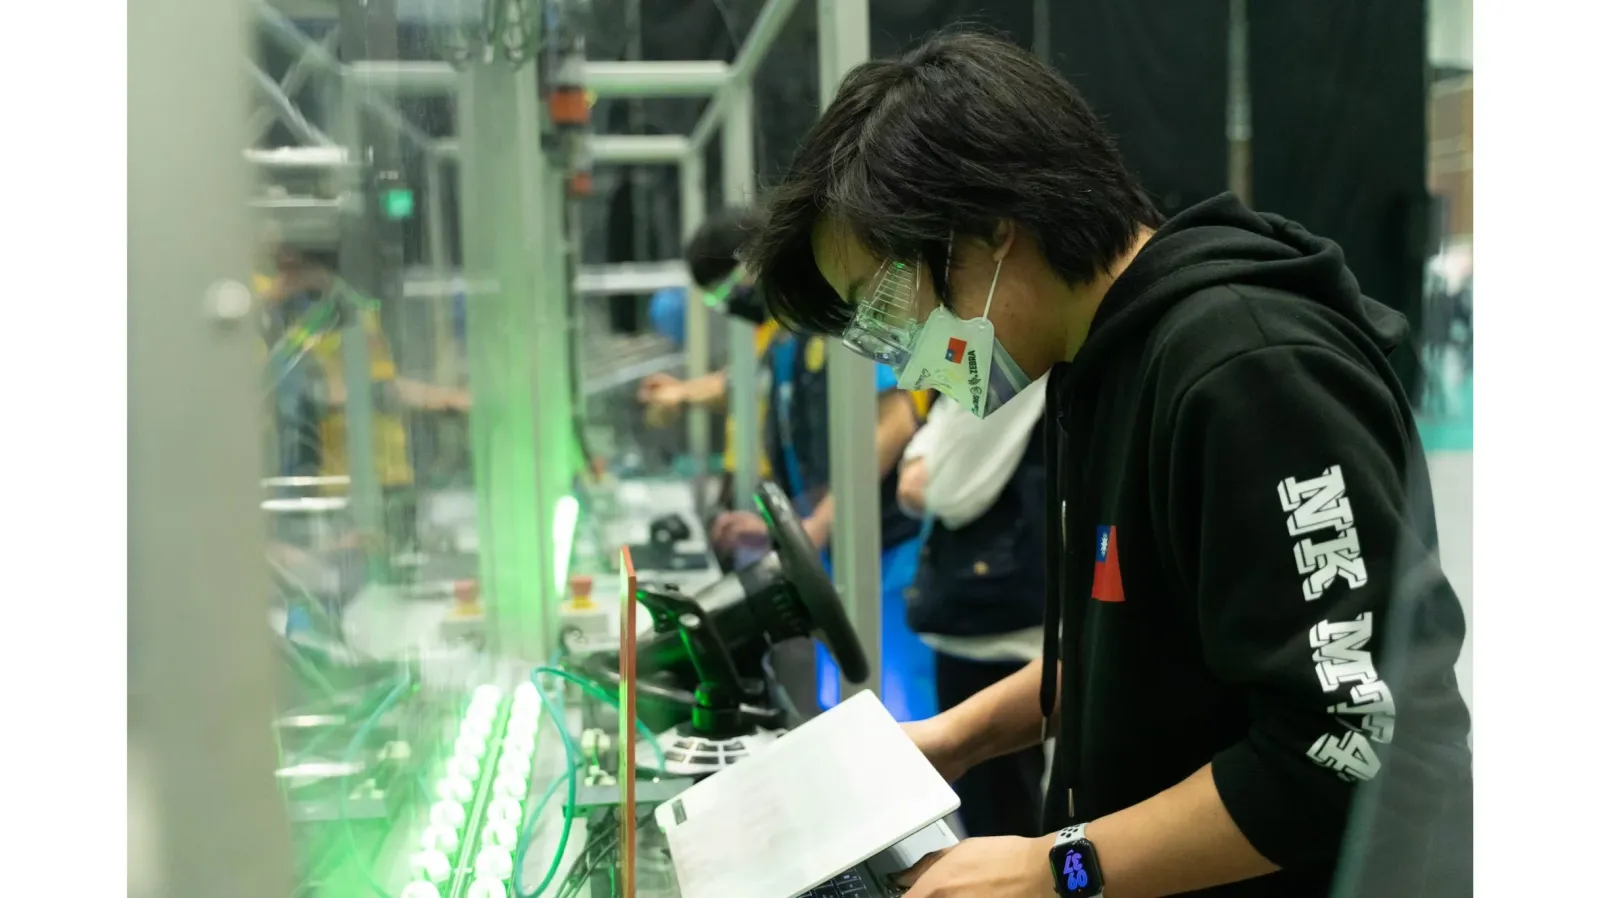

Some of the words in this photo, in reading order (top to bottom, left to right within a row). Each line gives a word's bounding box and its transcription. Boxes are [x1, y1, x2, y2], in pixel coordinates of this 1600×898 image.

[967, 349, 978, 374] ZEBRA
[1277, 464, 1368, 601] NK
[1063, 853, 1083, 875] 37
[1067, 869, 1088, 890] 09
